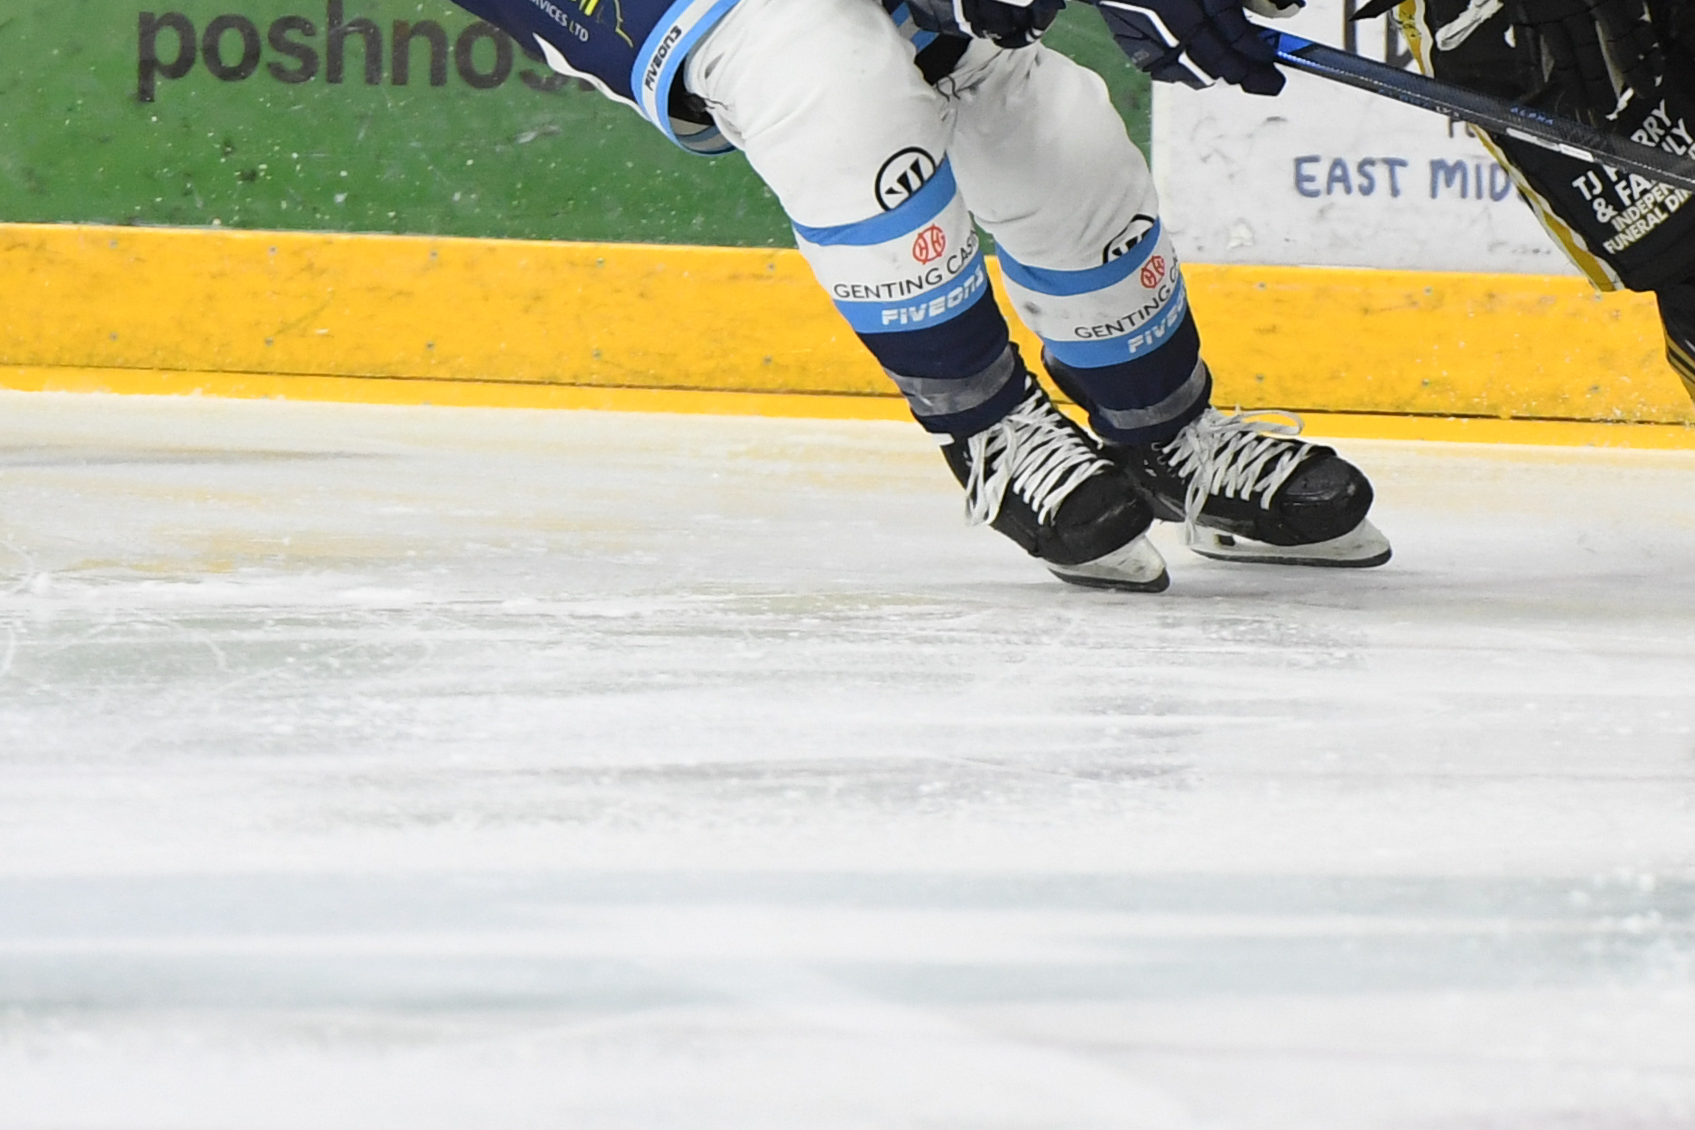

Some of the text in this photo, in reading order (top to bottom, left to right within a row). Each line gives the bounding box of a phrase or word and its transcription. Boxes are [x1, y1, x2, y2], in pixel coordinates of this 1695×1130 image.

[569, 20, 589, 42] LTD
[1294, 154, 1408, 198] EAST
[1572, 170, 1603, 201] TJ
[1593, 198, 1619, 223] &
[1603, 209, 1669, 254] FUNERAL
[833, 268, 943, 299] GENTING
[1074, 284, 1172, 340] GENTING
